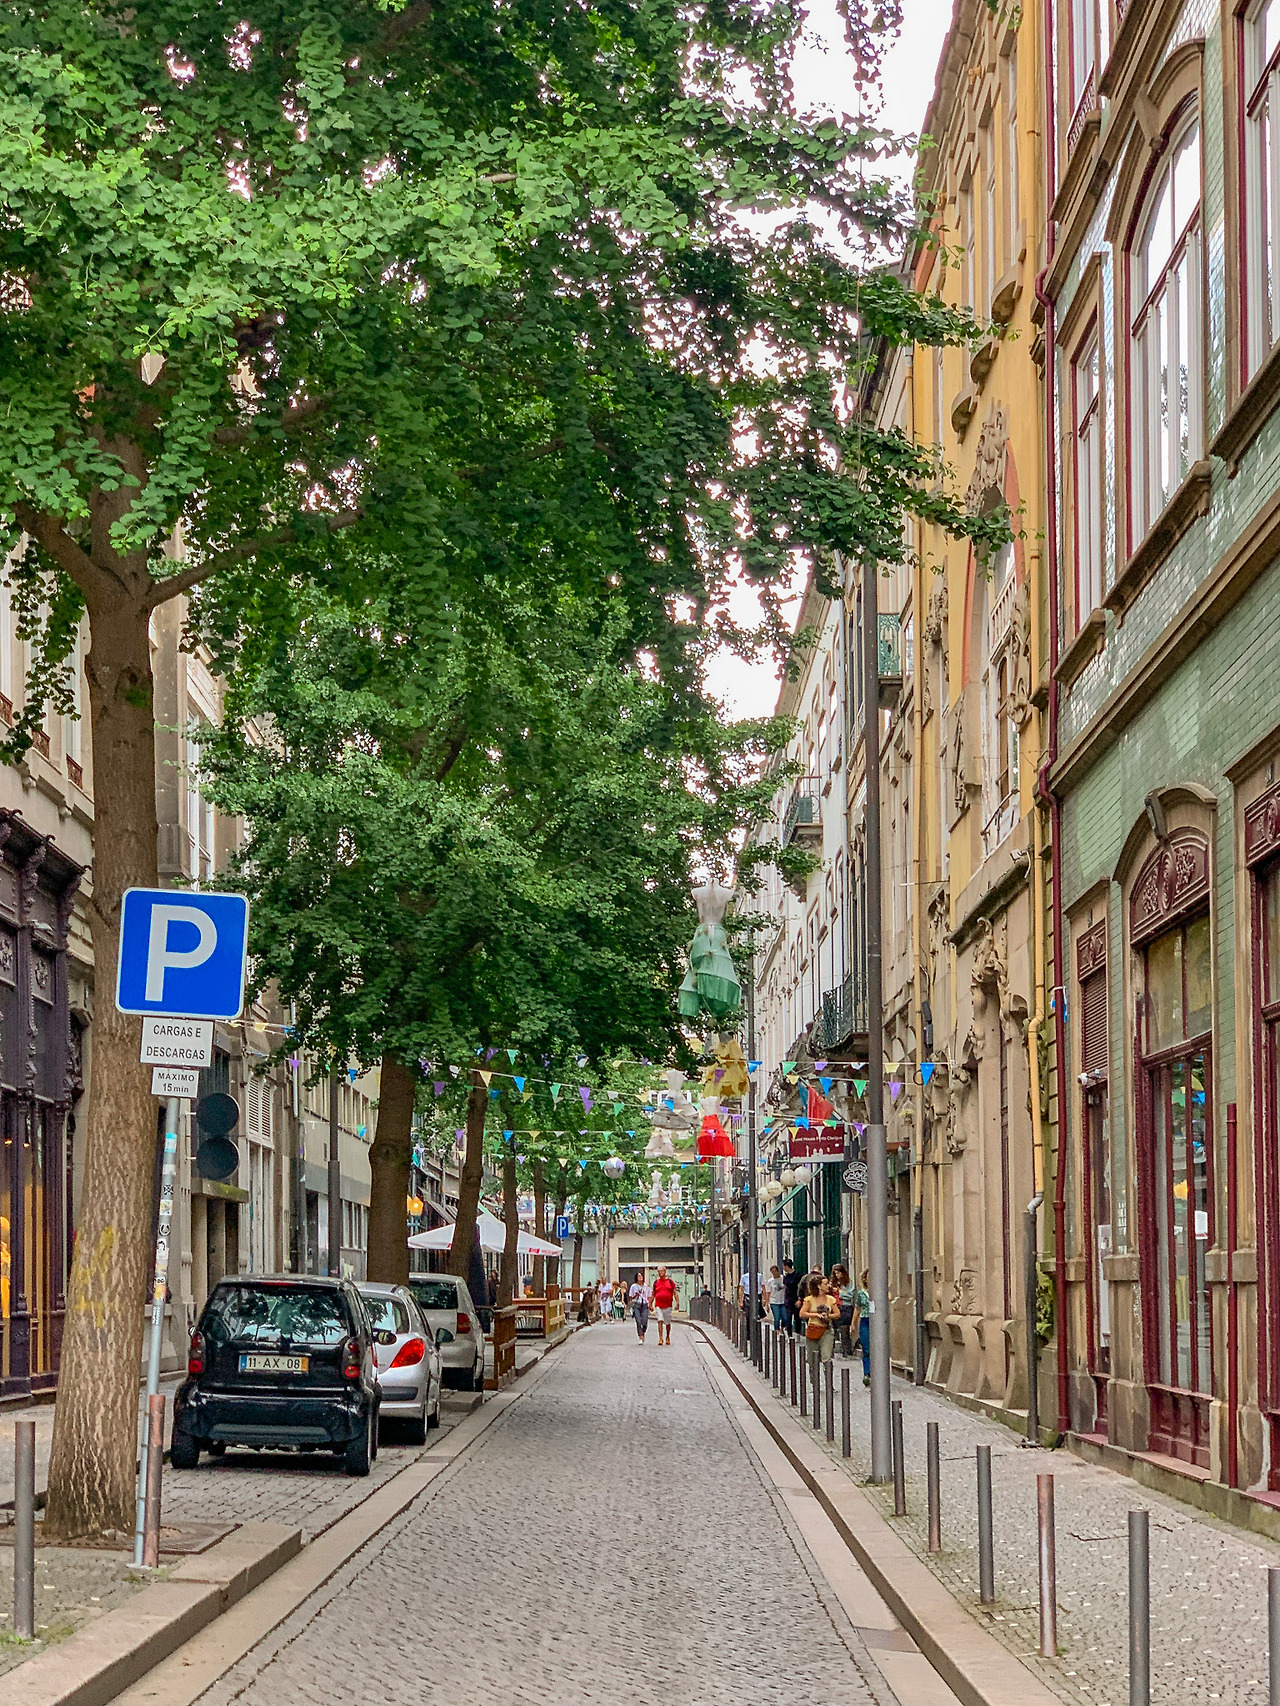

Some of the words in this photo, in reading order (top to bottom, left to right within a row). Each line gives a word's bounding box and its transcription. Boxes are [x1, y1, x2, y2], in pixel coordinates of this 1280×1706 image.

[144, 903, 218, 1002] P
[153, 1024, 193, 1037] CARGAS
[195, 1027, 202, 1038] E
[146, 1046, 205, 1060] DESCARGAS
[559, 1218, 567, 1236] P
